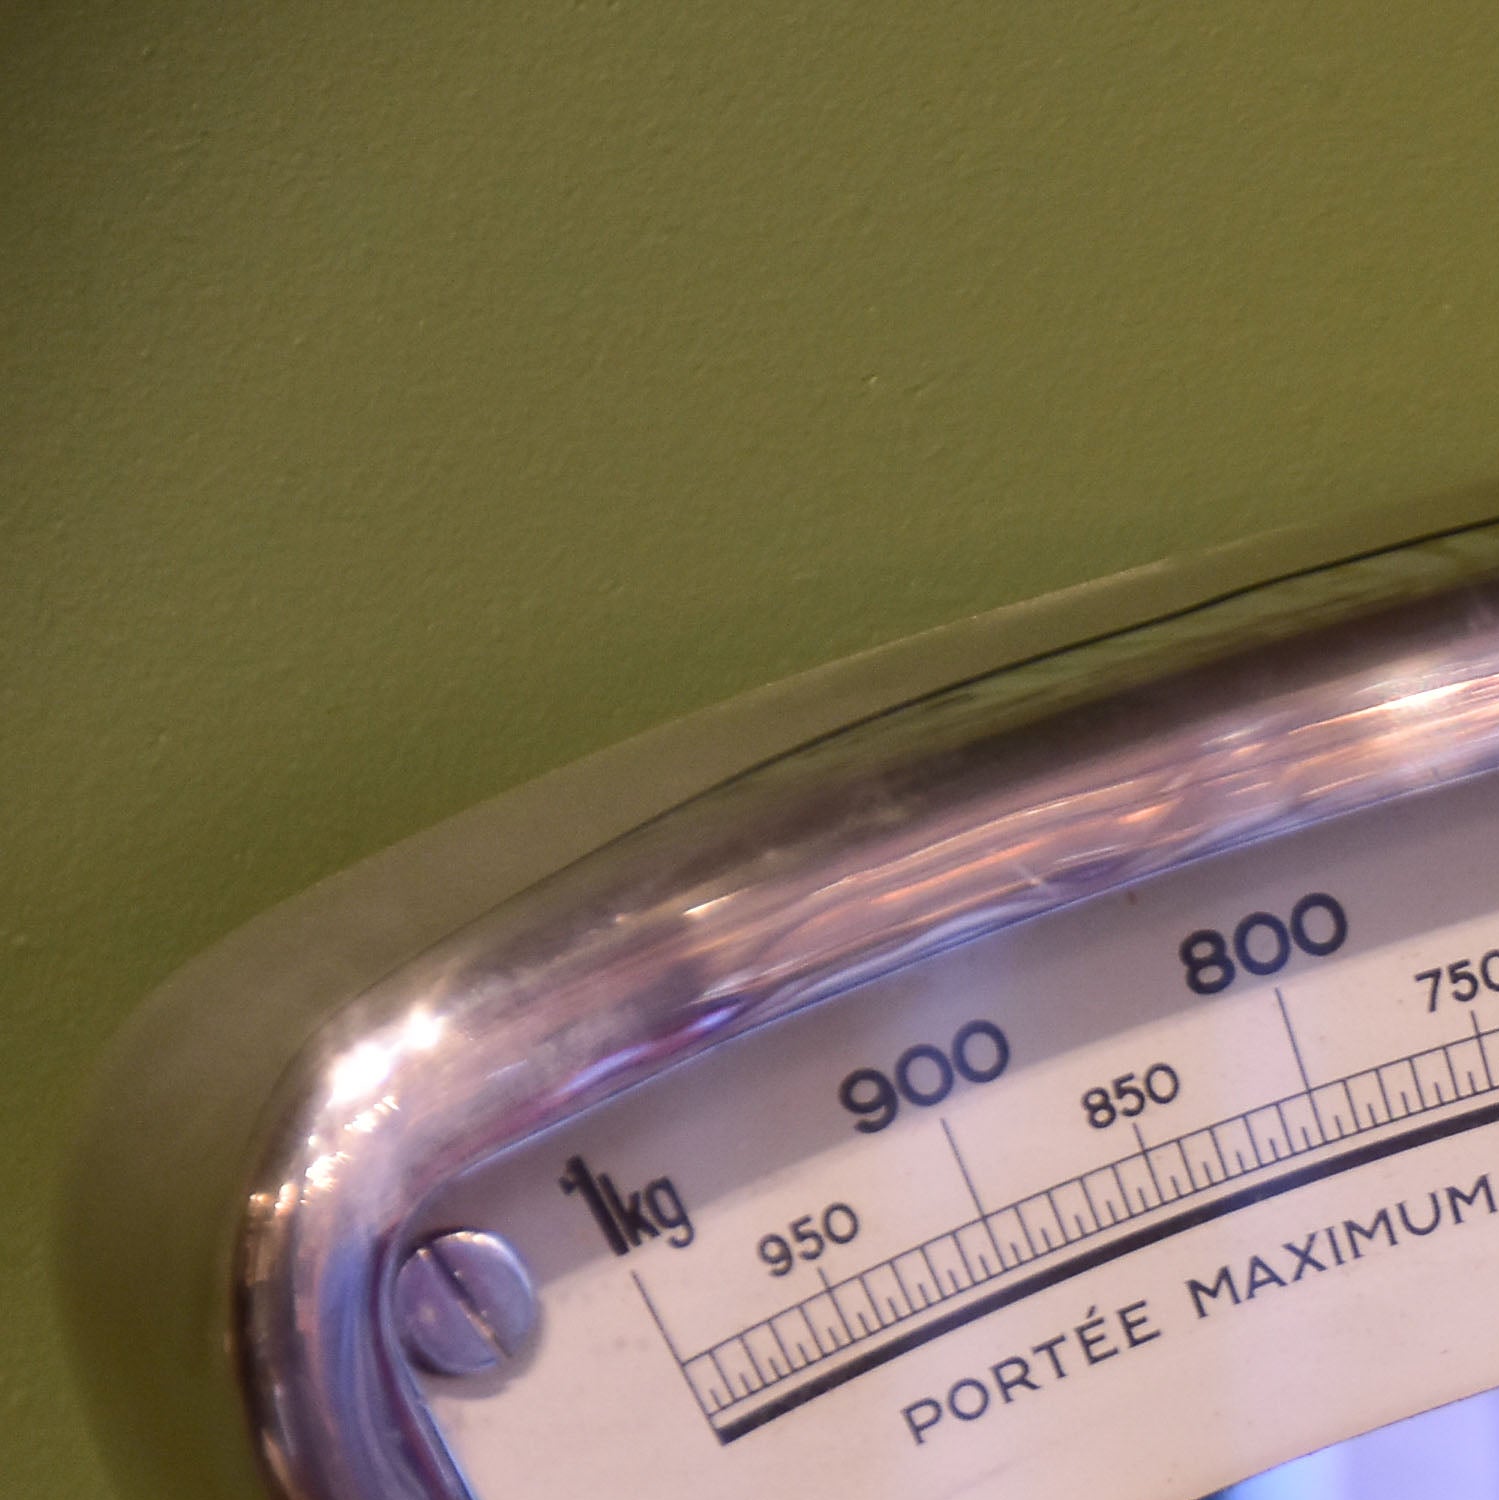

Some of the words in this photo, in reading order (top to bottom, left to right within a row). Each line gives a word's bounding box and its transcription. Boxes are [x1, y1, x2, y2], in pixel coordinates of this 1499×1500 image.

[1179, 893, 1348, 995] 800
[838, 1021, 1010, 1133] 900
[1081, 1063, 1180, 1129] 850
[758, 1203, 860, 1277] 950
[900, 1299, 1161, 1446] PORTÉE
[1184, 1174, 1498, 1319] MAXIMUM
